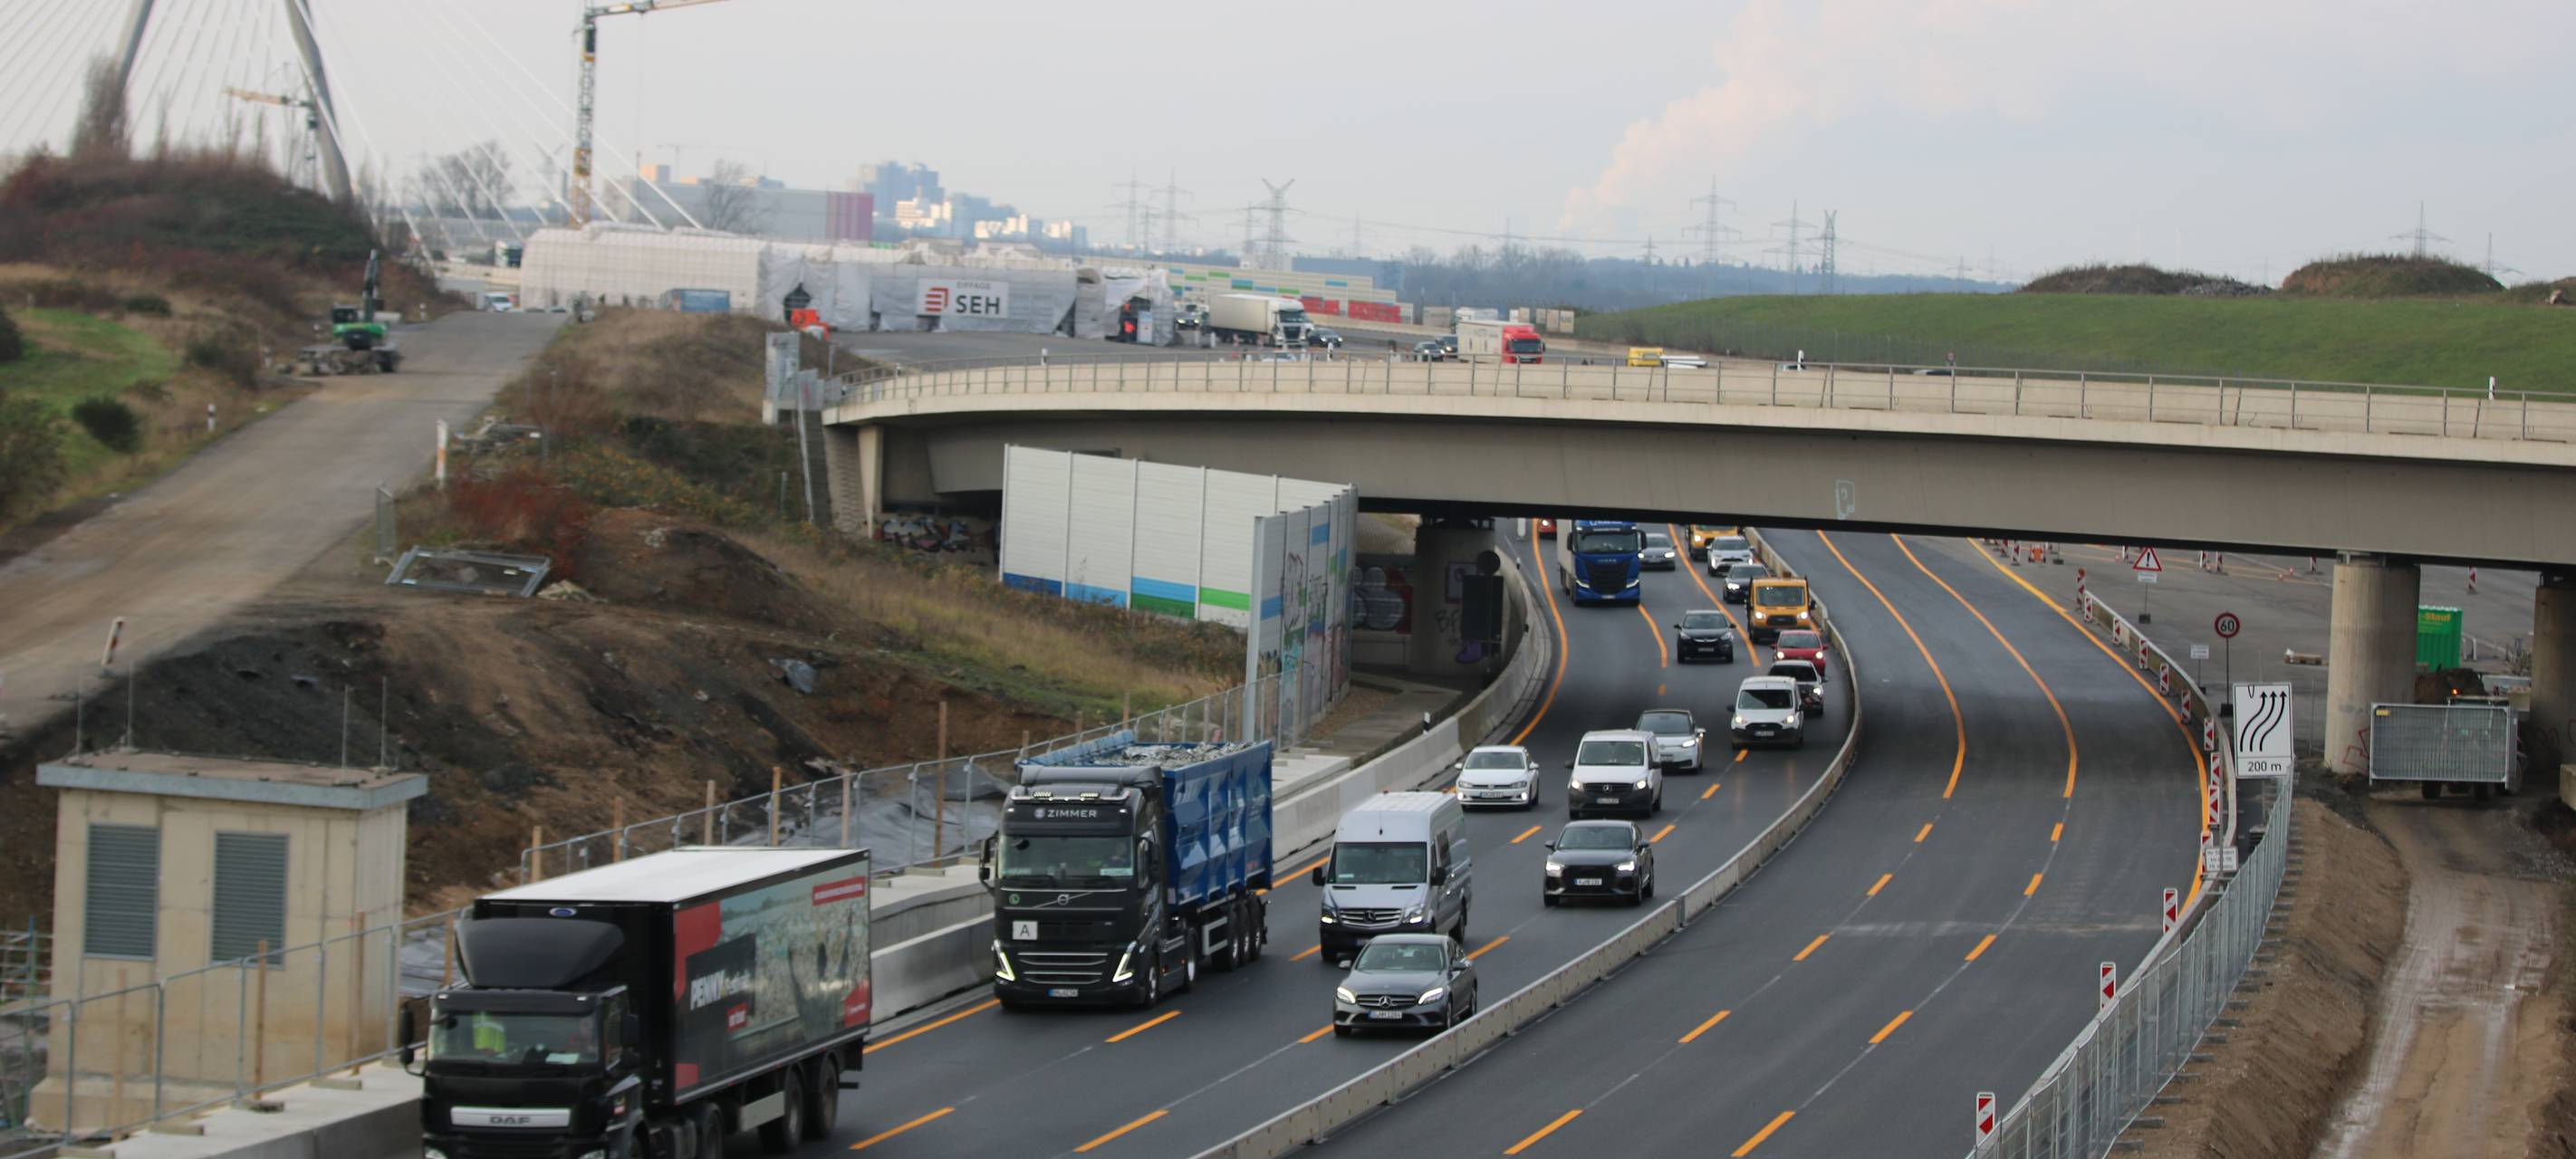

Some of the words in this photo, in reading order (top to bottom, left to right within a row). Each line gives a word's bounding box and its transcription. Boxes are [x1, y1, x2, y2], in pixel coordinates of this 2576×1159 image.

[956, 294, 1000, 314] SEH
[2220, 619, 2235, 632] 60
[2248, 761, 2267, 772] 200
[2271, 763, 2282, 771] m
[1047, 809, 1097, 818] ZIMMER
[1020, 924, 1030, 937] A
[689, 969, 726, 1011] PENNY
[490, 1116, 531, 1125] DAF
